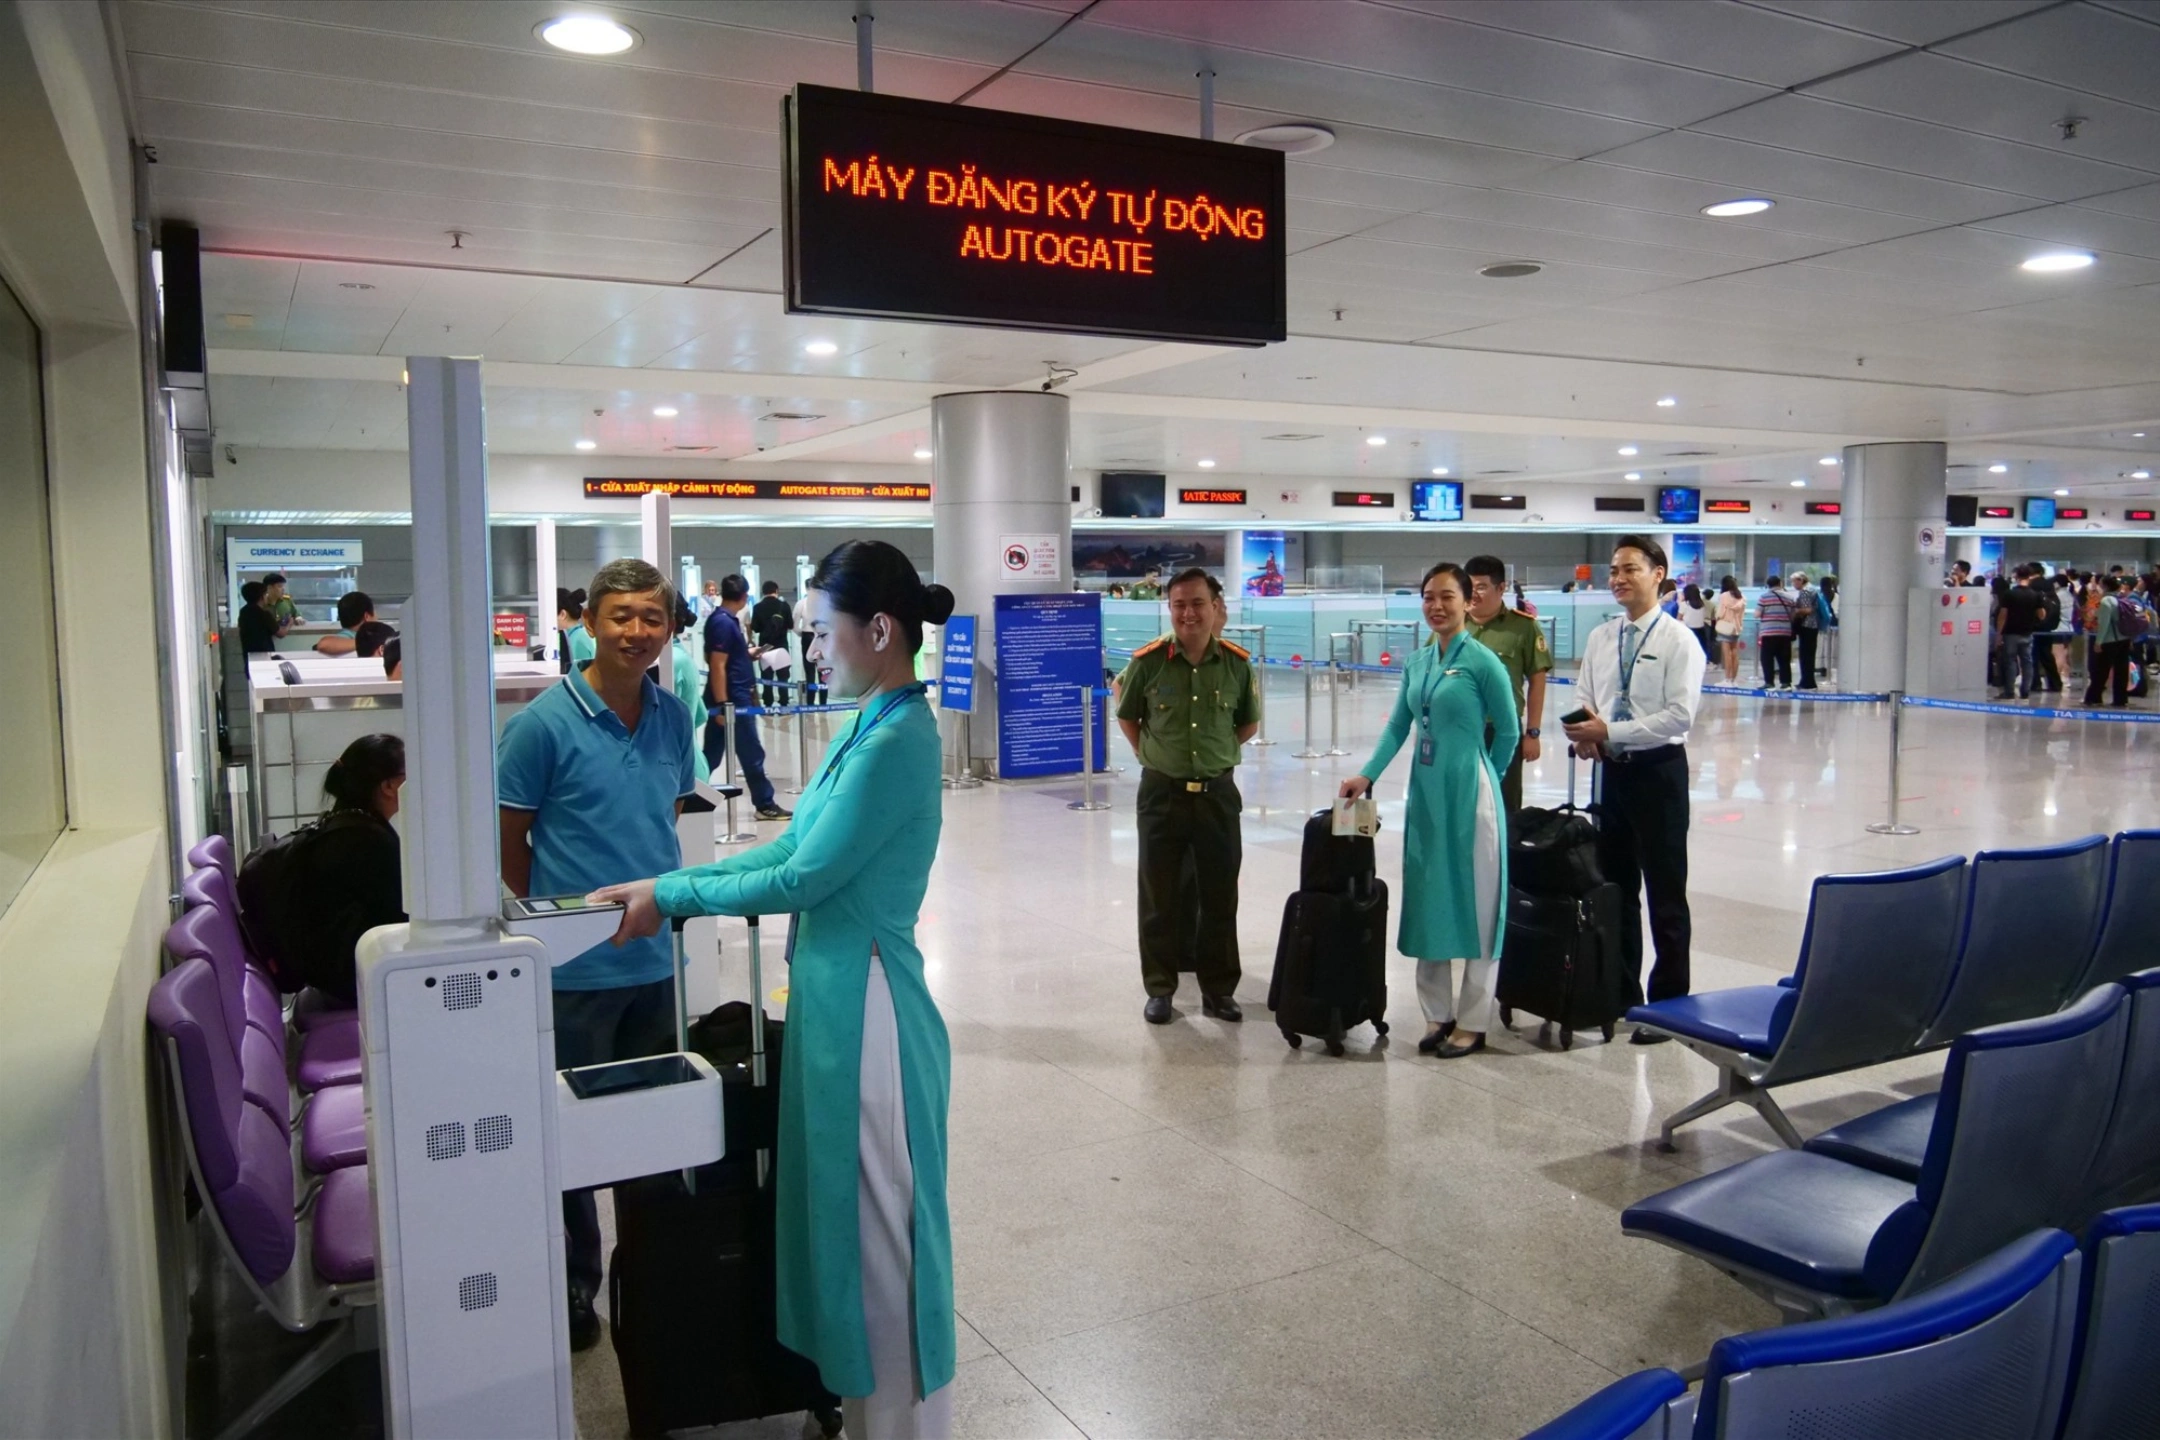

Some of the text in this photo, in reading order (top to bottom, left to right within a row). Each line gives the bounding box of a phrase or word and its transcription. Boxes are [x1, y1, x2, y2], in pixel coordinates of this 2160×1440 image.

[825, 155, 1264, 241] MÁY ĐĂNG KÝ TỰ ĐỘNG
[961, 225, 1153, 274] AUTOGATE
[726, 483, 756, 495] ĐỘNG
[780, 485, 829, 495] AUTOGATE
[829, 486, 865, 496] SYSTEM
[250, 548, 345, 556] CURRENCY EXCHANGE
